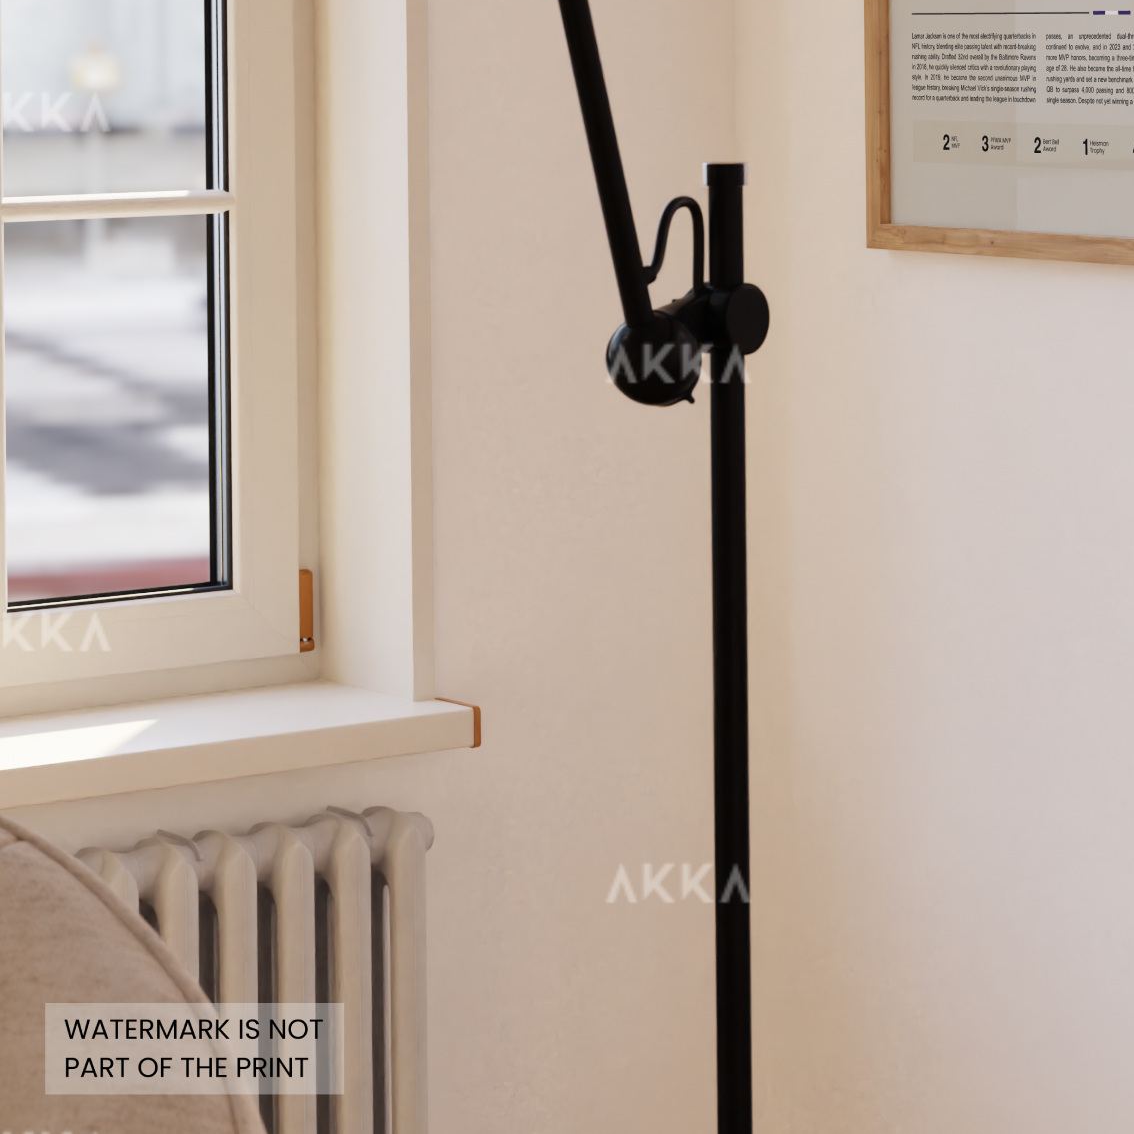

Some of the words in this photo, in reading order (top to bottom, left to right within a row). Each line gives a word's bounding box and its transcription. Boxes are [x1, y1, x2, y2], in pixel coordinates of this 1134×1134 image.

[943, 134, 950, 150] 2
[982, 135, 989, 152] 3
[1034, 137, 1041, 153] 2
[1083, 138, 1088, 155] 1
